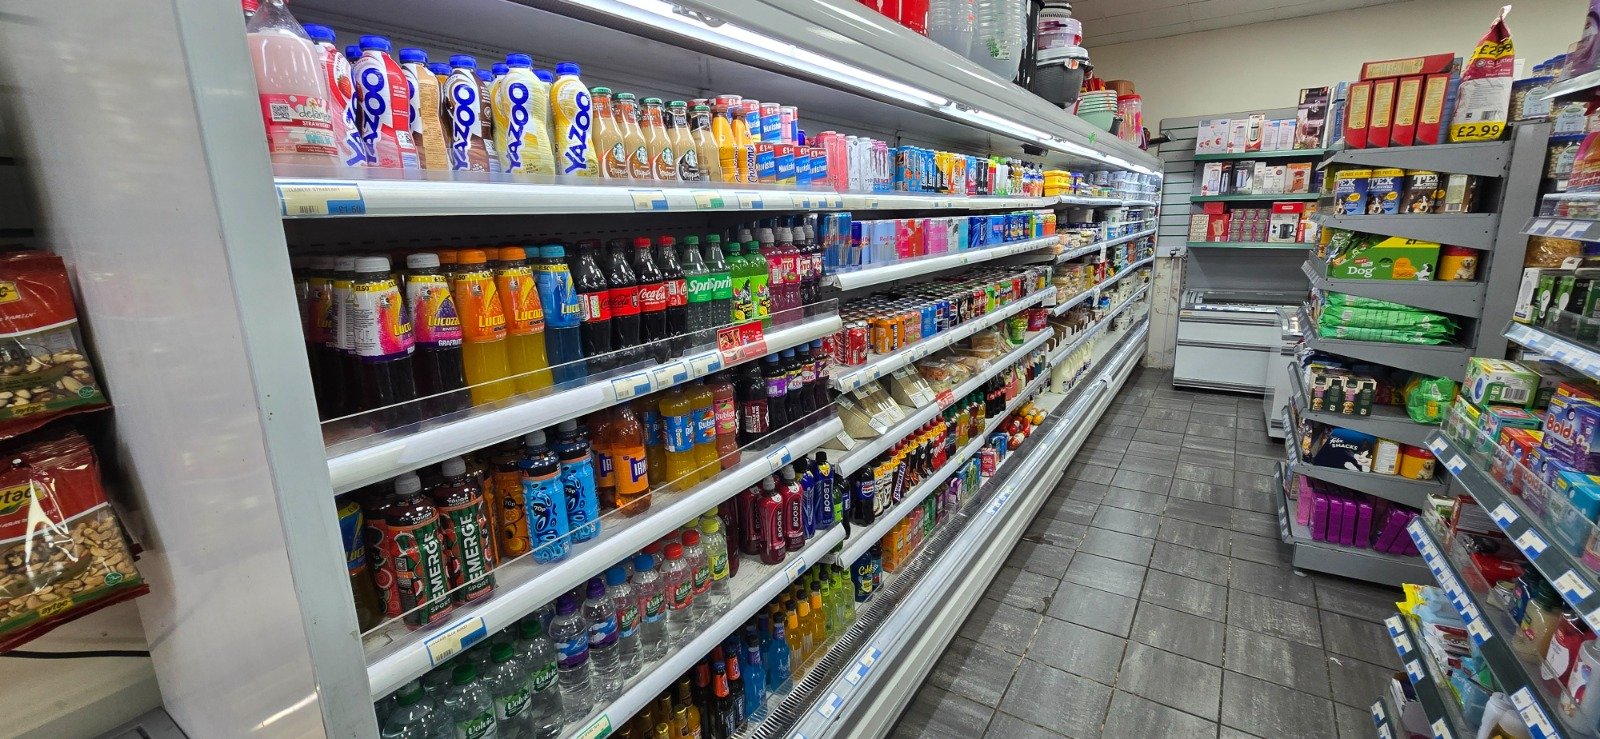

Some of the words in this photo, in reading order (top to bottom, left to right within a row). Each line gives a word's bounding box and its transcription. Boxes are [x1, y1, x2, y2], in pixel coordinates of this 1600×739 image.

[453, 84, 476, 171] YAZOO
[505, 82, 529, 174] YAZOO
[564, 91, 590, 174] YAZOO
[1457, 125, 1500, 137] £2.99
[1347, 266, 1376, 278] Dog
[688, 279, 711, 295] Spri
[1547, 413, 1574, 440] Bold
[1332, 443, 1358, 451] SNACKS
[0, 486, 31, 504] tac
[504, 500, 516, 508] 70p
[533, 504, 547, 513] 70p
[460, 513, 486, 584] EMERGE
[424, 530, 448, 604] EMERGE
[468, 578, 489, 592] SPORT
[41, 600, 68, 615] aytac
[431, 597, 452, 613] SPORT
